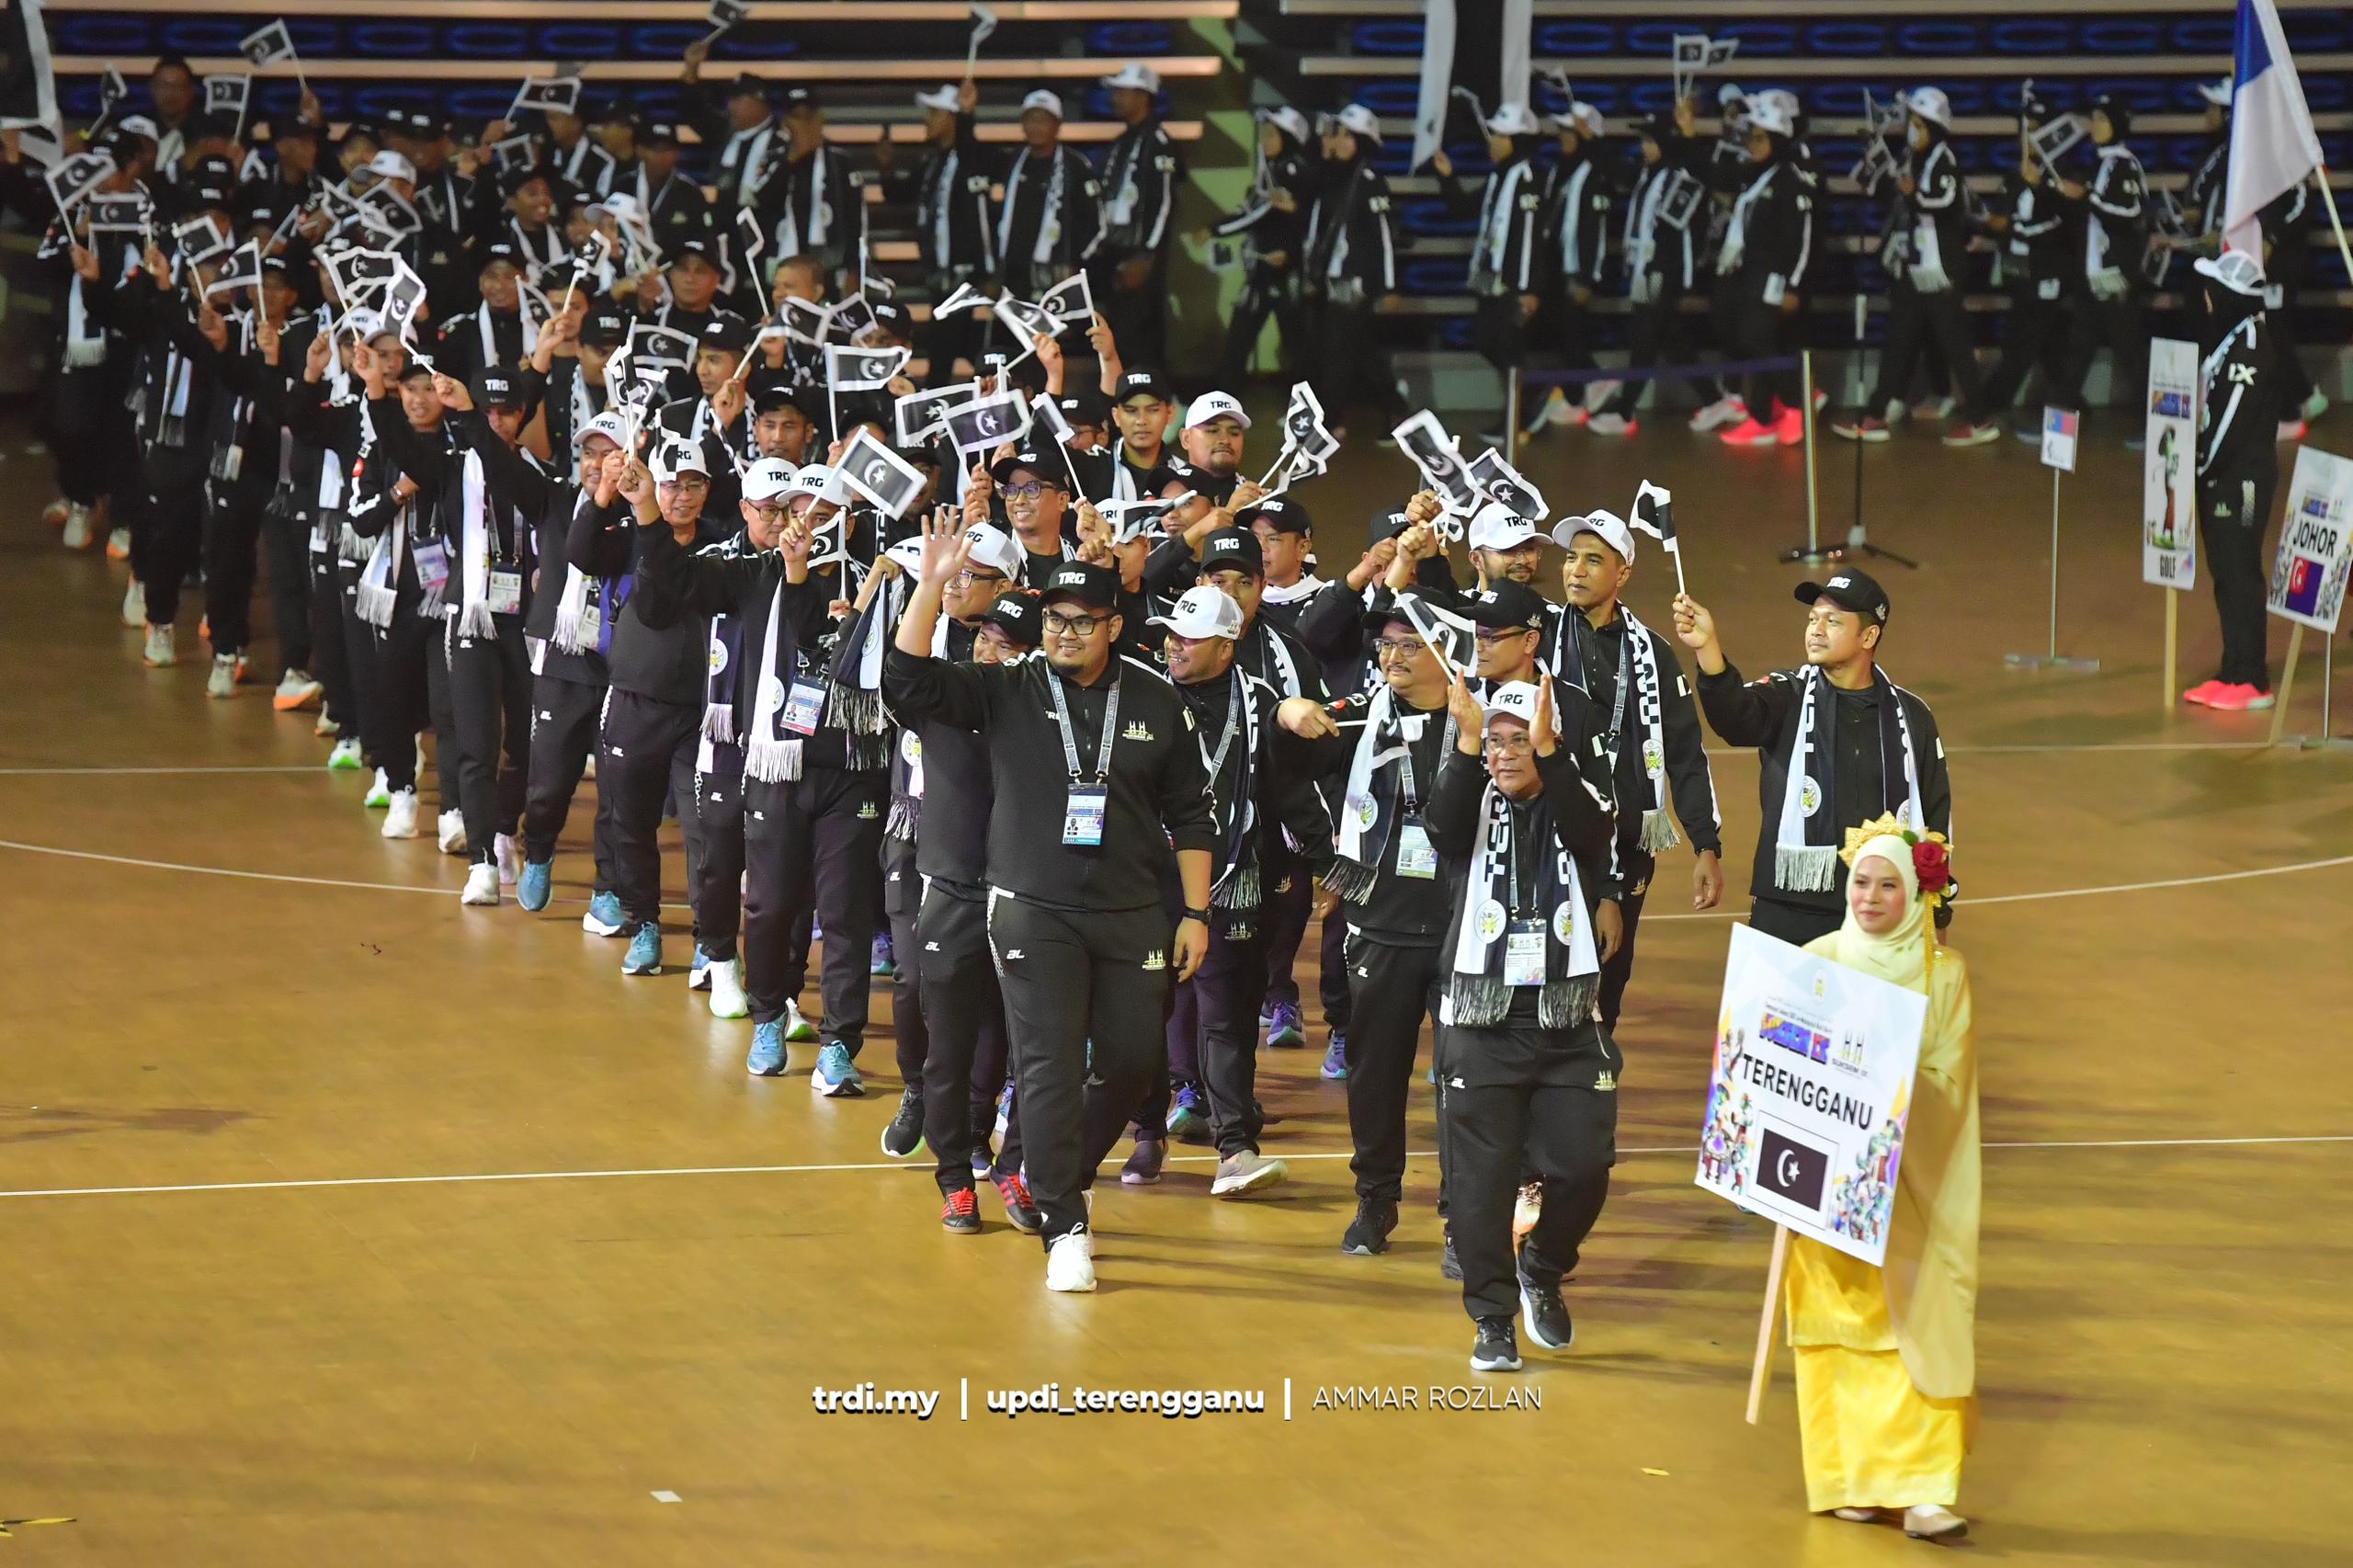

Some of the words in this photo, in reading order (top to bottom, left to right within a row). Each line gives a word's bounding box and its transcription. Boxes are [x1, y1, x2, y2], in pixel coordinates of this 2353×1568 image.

[1127, 373, 1152, 385] TRG
[484, 379, 509, 392] TRG
[1211, 401, 1232, 409] TRG
[676, 450, 691, 460] RG
[767, 472, 790, 482] TRG
[801, 477, 824, 487] TRG
[1261, 500, 1283, 512] TRG
[1388, 513, 1407, 524] TR
[1505, 516, 1528, 528] TRG
[1213, 538, 1240, 551] TRG
[2292, 520, 2338, 558] JOHOR
[2160, 553, 2177, 579] GOLF
[1058, 571, 1086, 585] TRG
[997, 599, 1024, 619] TRG
[1176, 599, 1197, 613] TRG
[1498, 694, 1523, 705] TRG
[1743, 1053, 1874, 1131] TERENGGANU
